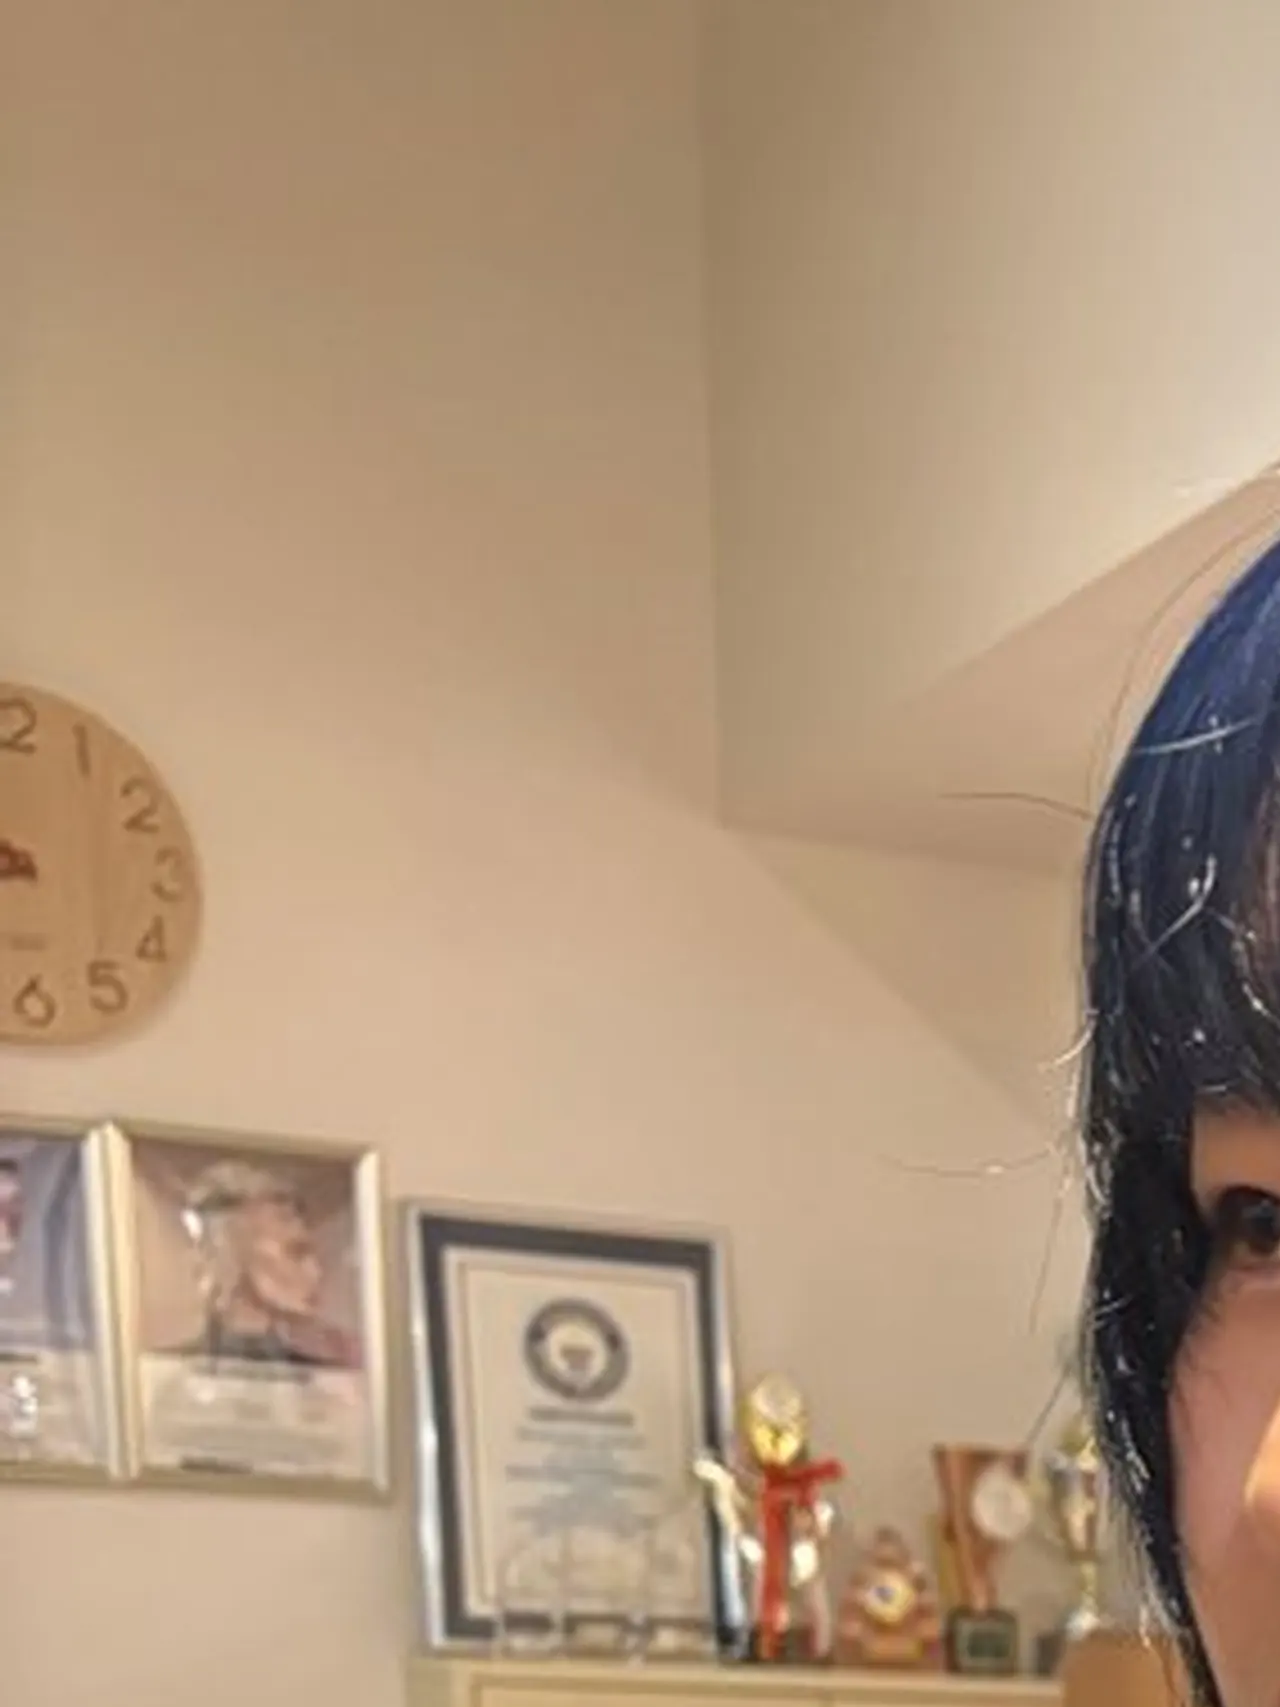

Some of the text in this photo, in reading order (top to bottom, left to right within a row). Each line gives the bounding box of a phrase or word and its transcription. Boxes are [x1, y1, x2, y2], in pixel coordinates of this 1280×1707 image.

[72, 724, 92, 779] 1
[119, 777, 161, 834] 2
[150, 846, 186, 904] 3
[136, 915, 168, 963] 4
[12, 973, 56, 1029] 6
[86, 960, 129, 1014] 5
